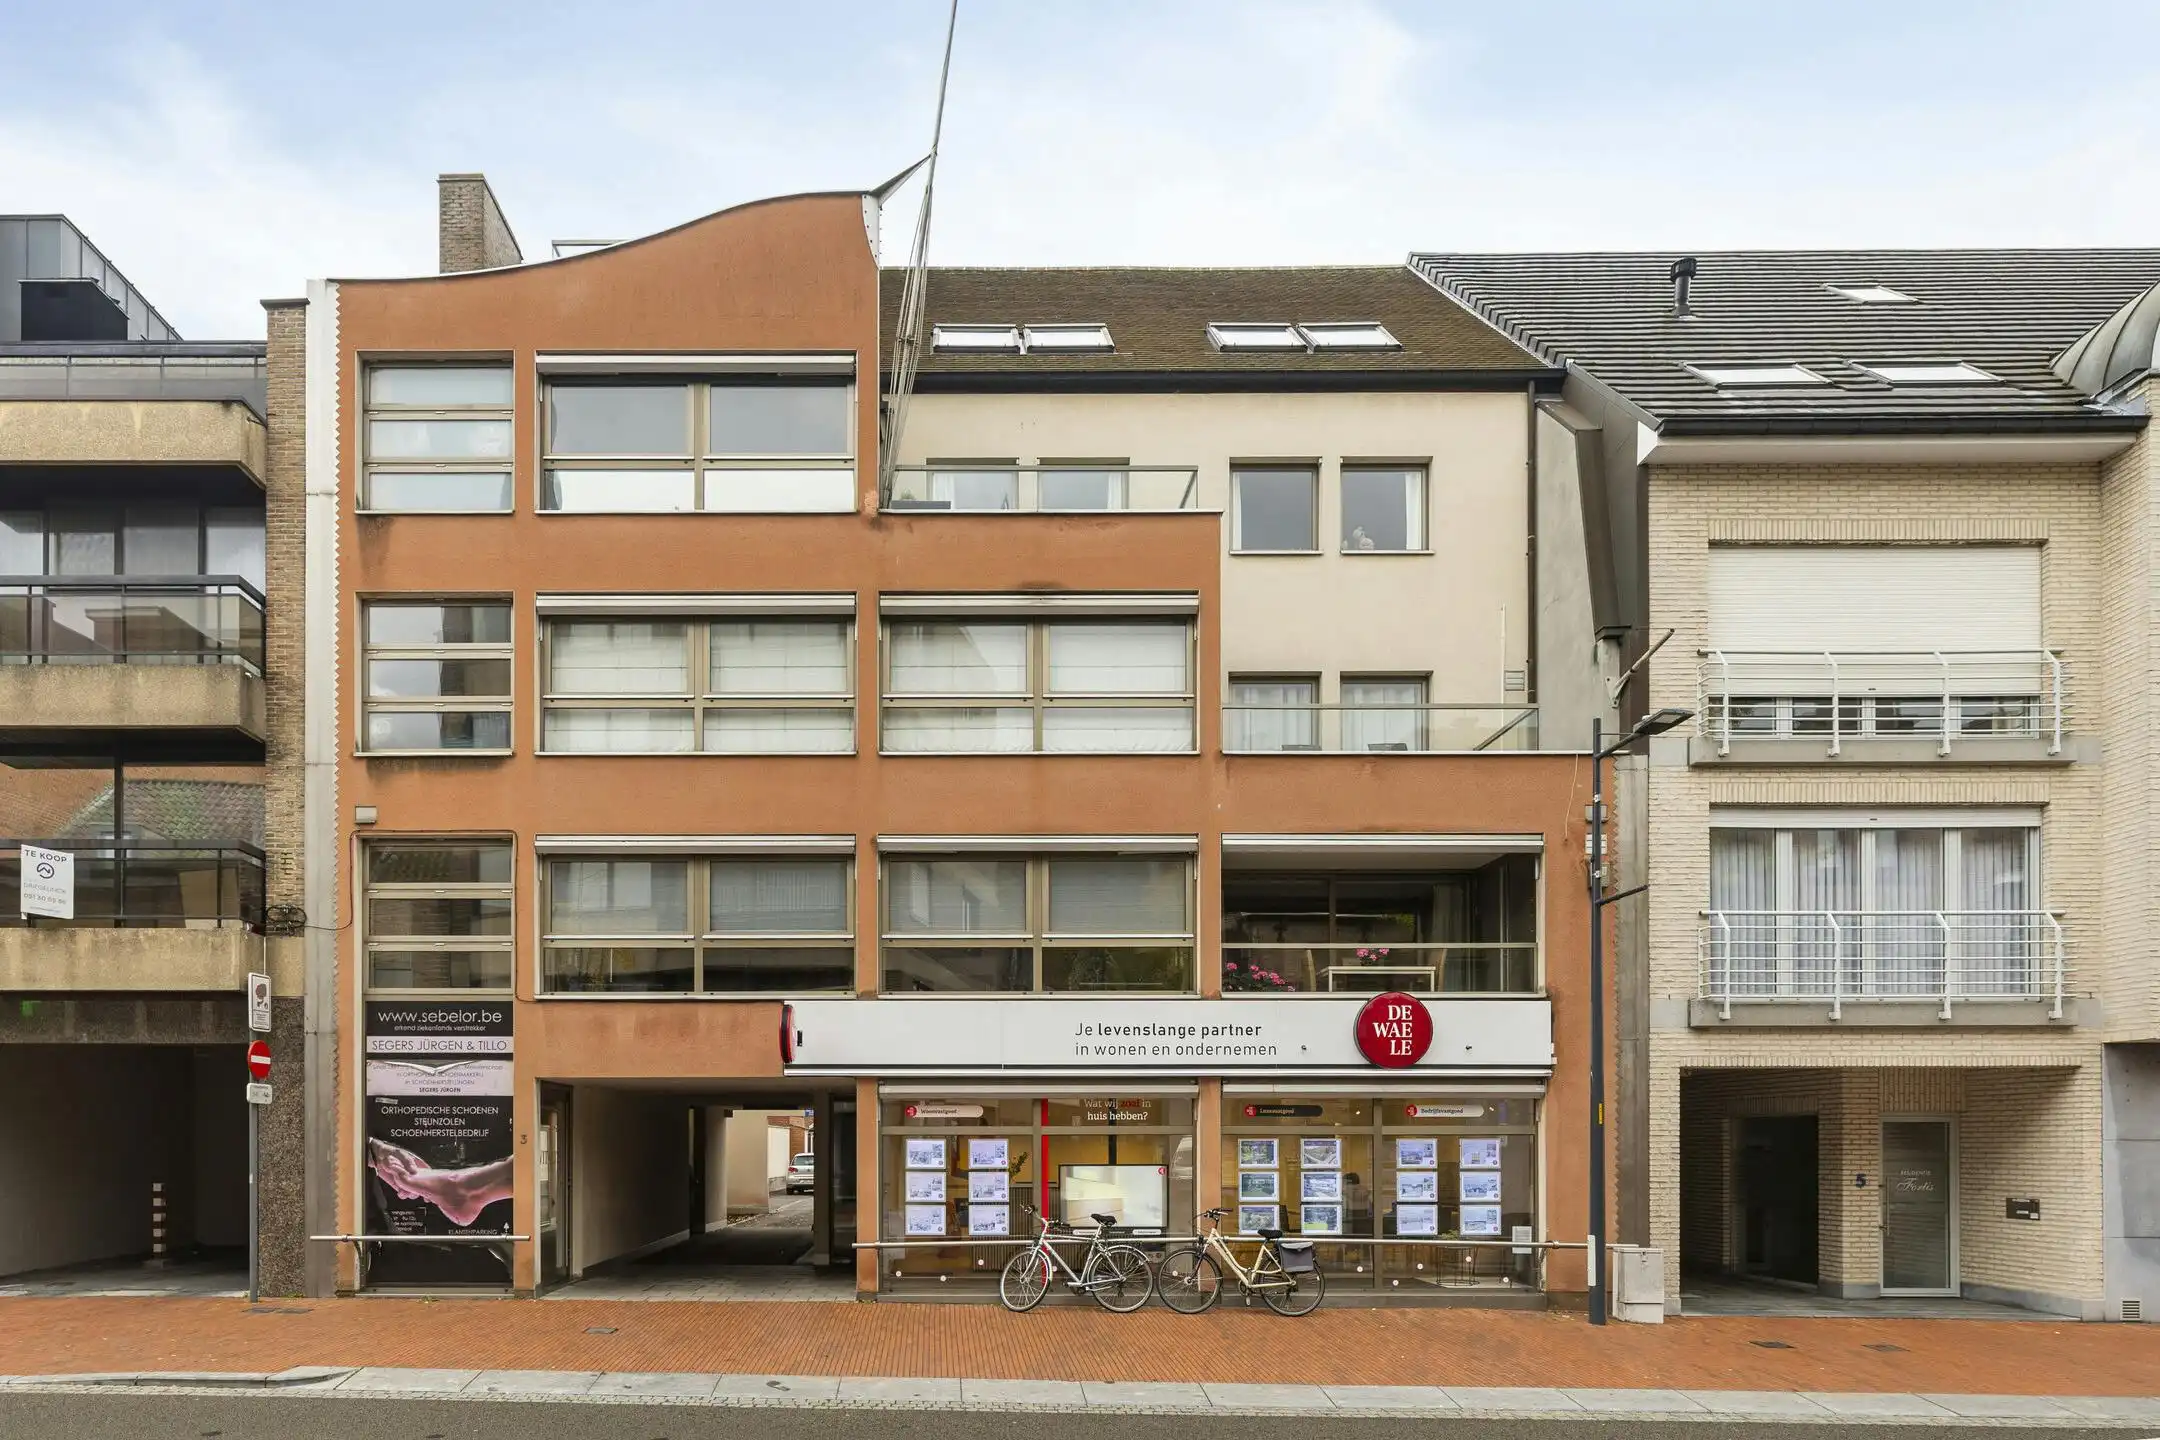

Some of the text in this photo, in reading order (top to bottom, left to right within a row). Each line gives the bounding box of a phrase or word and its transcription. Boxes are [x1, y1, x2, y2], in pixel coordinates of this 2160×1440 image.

[40, 852, 67, 862] KOOP
[378, 1009, 502, 1023] www.sebelor.be
[1388, 1005, 1412, 1020] DE
[1075, 1022, 1262, 1039] Je levenslange partner
[1372, 1022, 1412, 1038] WAE
[372, 1038, 507, 1050] SEGERS JÜRGEN & TILLO
[1075, 1042, 1278, 1056] in wonen en ondernemen
[1390, 1040, 1412, 1056] LE
[1084, 1098, 1102, 1108] Wat
[1104, 1098, 1118, 1110] wij
[1142, 1098, 1152, 1108] in
[381, 1106, 499, 1115] ORTHOPEDISCHE SCHOENEN
[1088, 1111, 1148, 1120] huis hebben?
[414, 1118, 466, 1126] STEUNZOLEN
[390, 1128, 490, 1137] SCHOENHERSTELBEDRIJF
[520, 1134, 528, 1144] 3
[1856, 1173, 1866, 1188] 5
